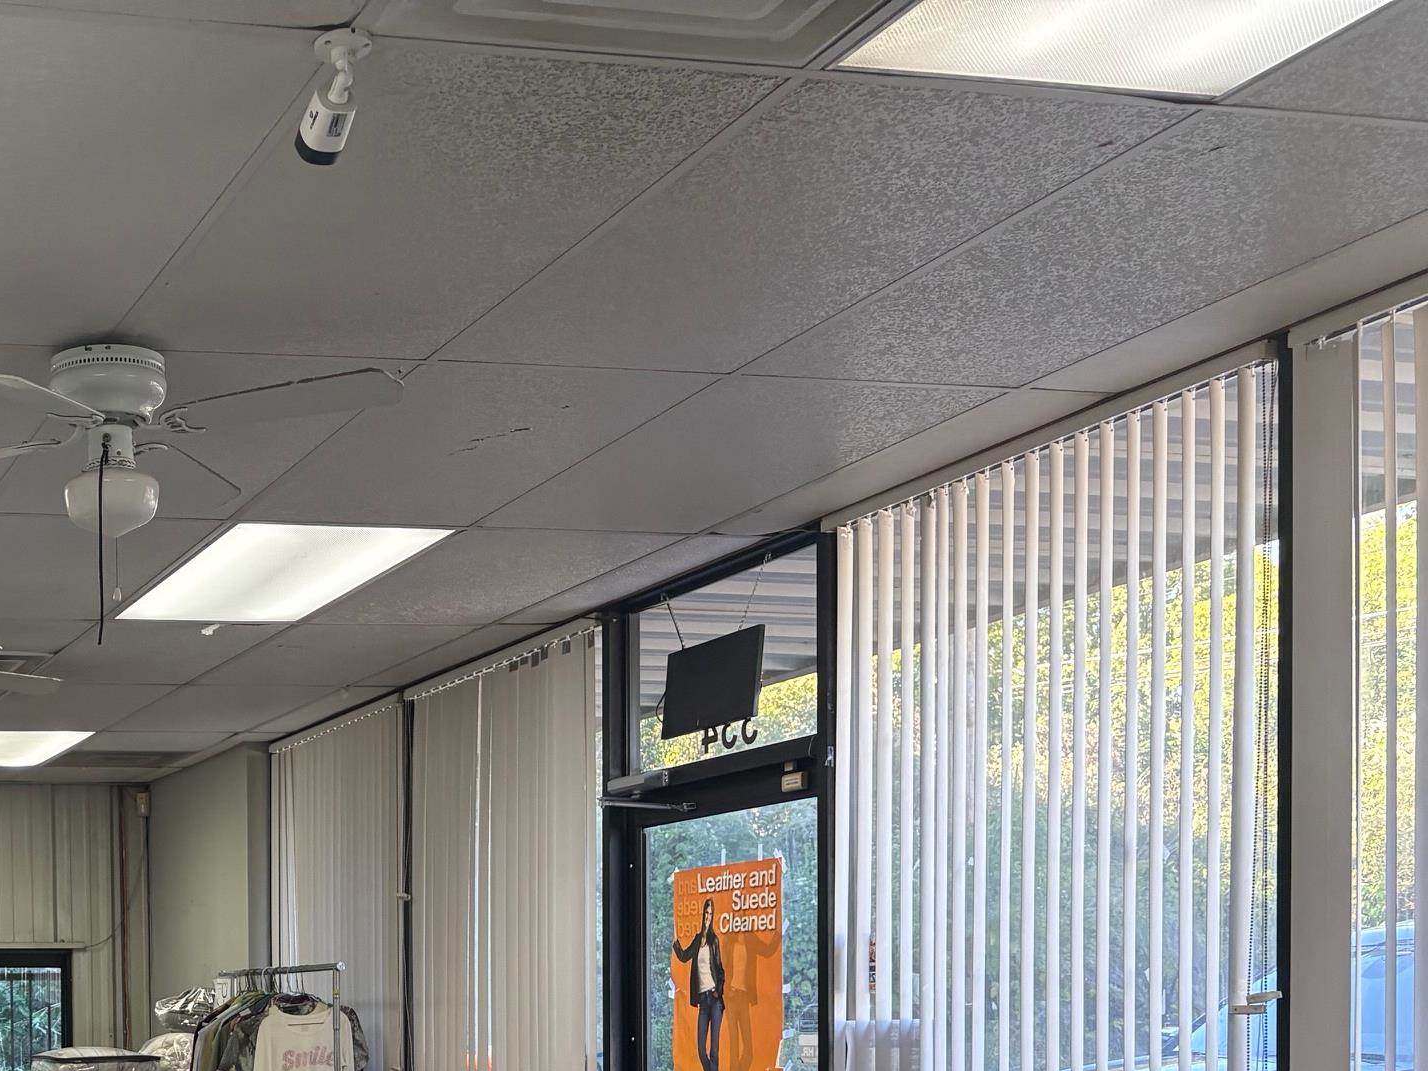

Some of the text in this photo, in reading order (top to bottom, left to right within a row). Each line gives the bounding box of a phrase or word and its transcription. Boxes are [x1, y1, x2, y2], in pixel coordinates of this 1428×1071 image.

[697, 863, 777, 894] Leather and
[731, 887, 777, 912] Suede
[719, 910, 777, 934] Cleaned
[283, 1045, 334, 1071] Smile
